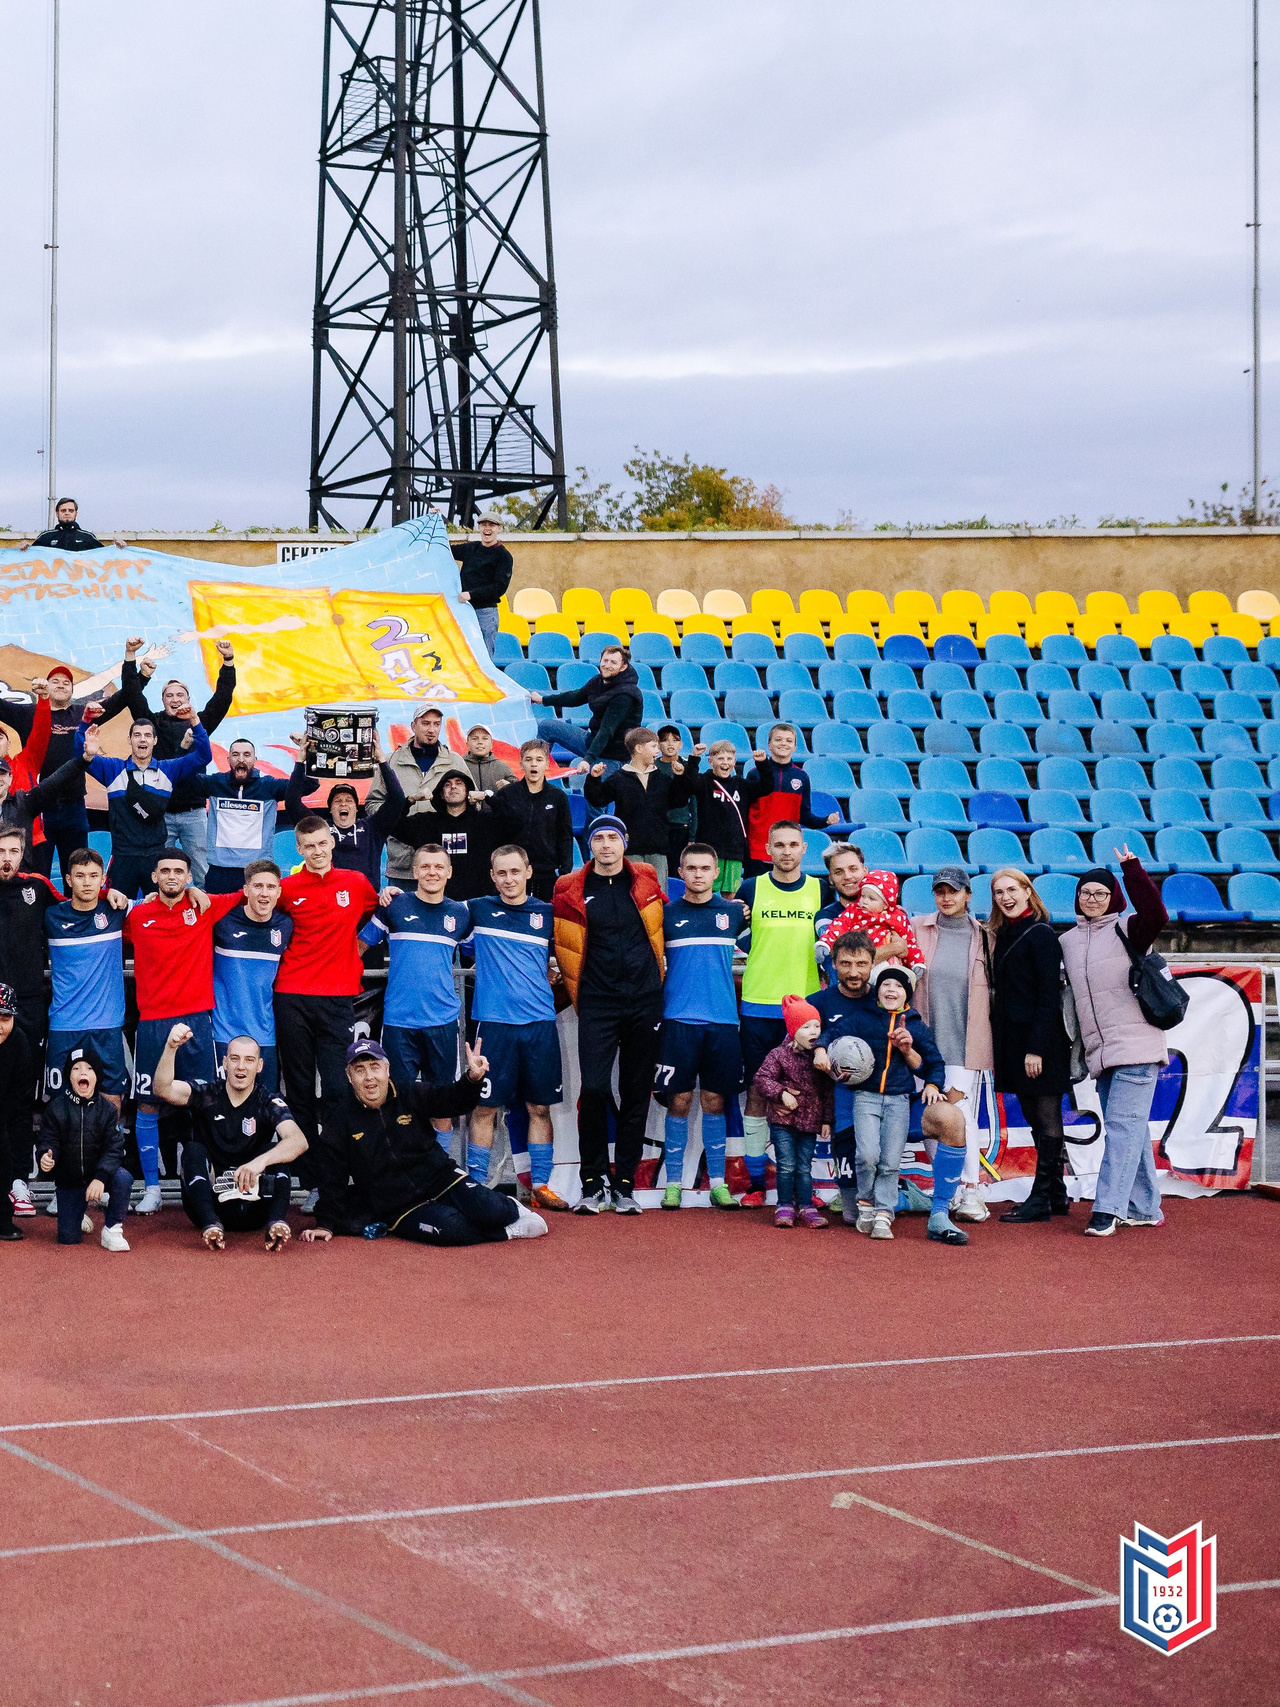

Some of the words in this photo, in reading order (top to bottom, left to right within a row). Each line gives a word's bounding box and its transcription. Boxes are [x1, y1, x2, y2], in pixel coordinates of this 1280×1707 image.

[220, 800, 248, 810] ellesse
[761, 909, 806, 919] KELME
[654, 1063, 676, 1086] 77
